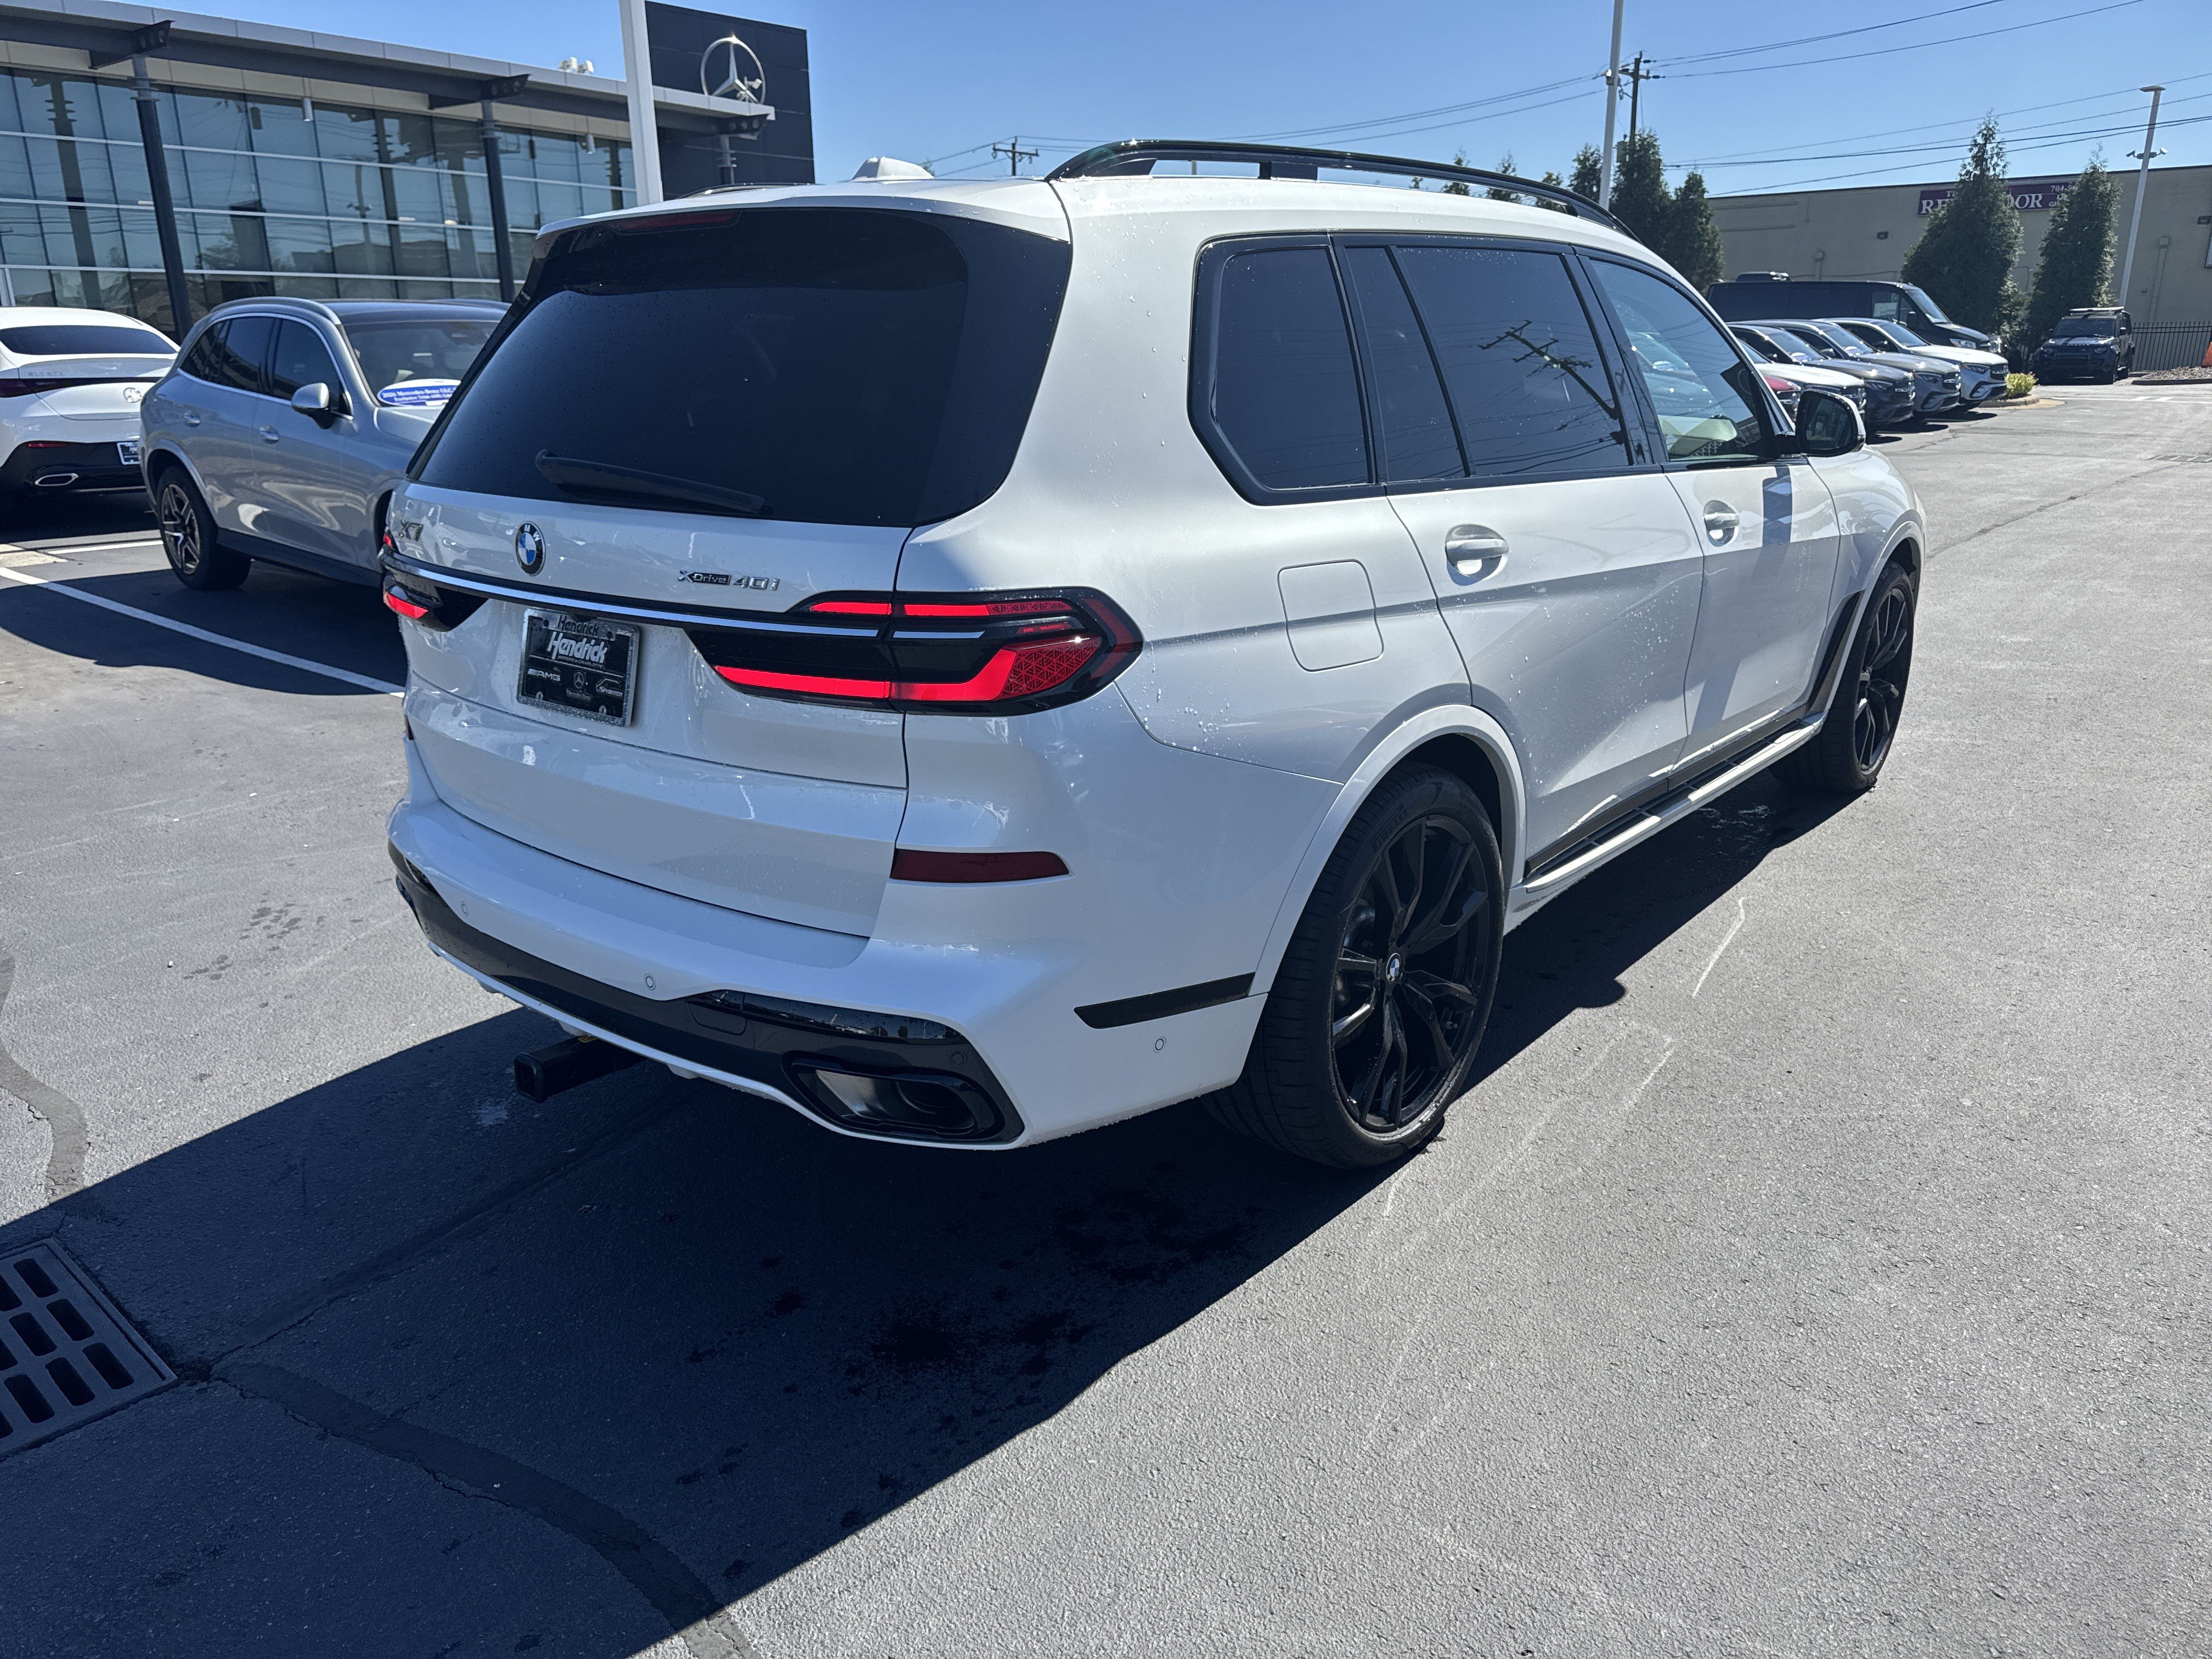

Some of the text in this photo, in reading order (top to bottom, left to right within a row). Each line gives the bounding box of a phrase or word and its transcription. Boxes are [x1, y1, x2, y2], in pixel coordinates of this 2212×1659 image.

[399, 519, 424, 541] X7
[558, 614, 599, 636] Hendrick
[547, 631, 607, 663] Hendrick
[537, 670, 561, 681] AMG
